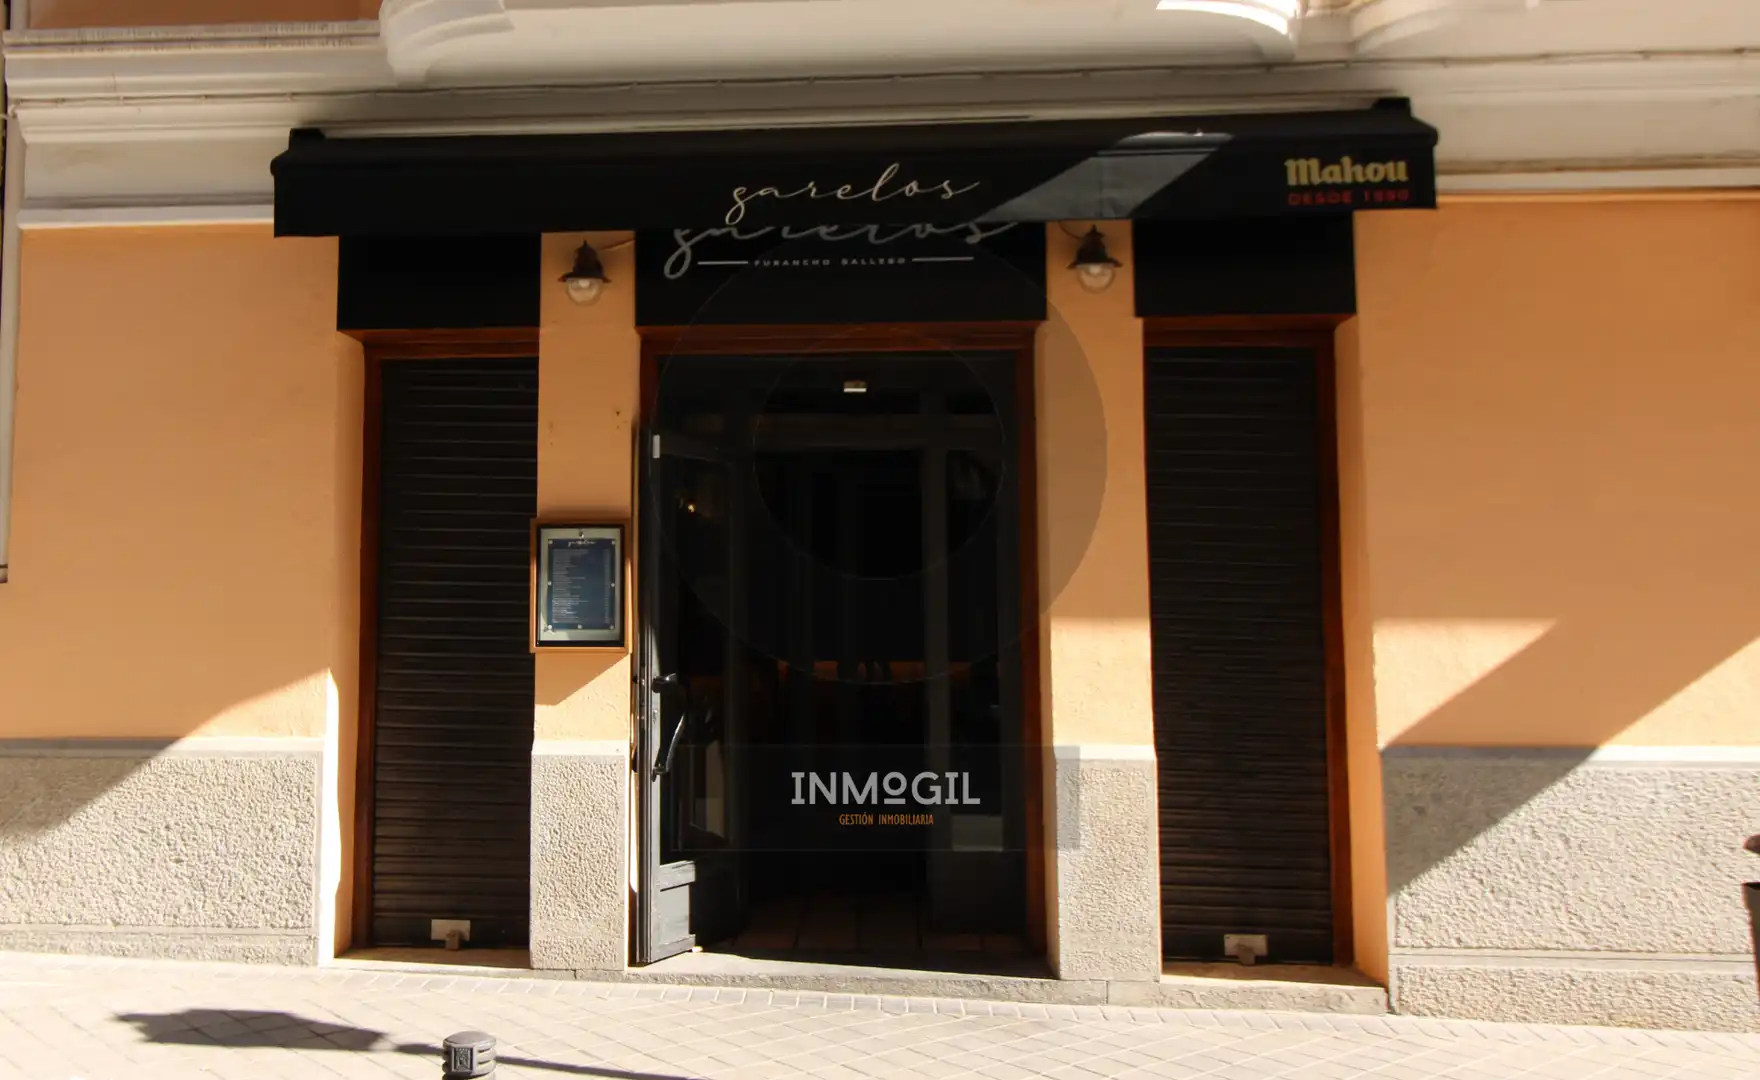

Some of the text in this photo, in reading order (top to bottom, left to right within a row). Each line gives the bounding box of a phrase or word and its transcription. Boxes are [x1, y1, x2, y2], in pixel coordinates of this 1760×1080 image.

[1284, 155, 1409, 186] Mahou
[724, 162, 981, 226] garelos
[1288, 190, 1353, 206] DESDE
[753, 256, 907, 268] FURANCHO GALLEGO
